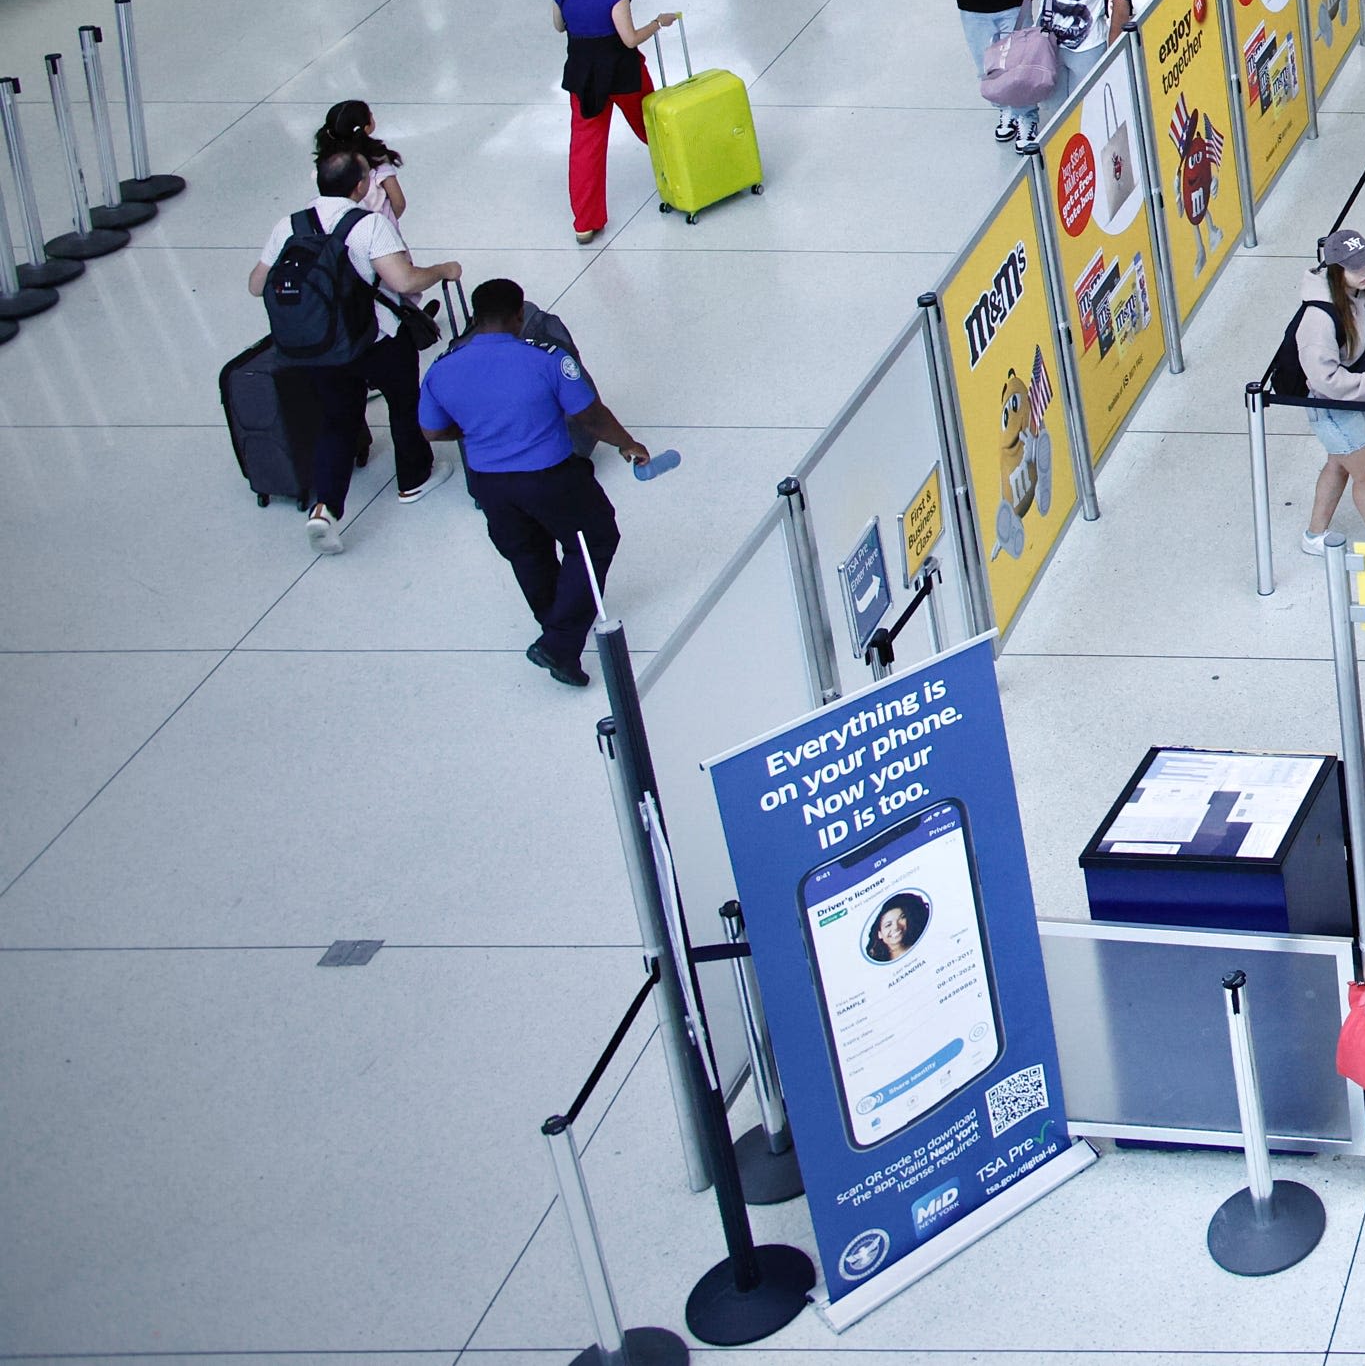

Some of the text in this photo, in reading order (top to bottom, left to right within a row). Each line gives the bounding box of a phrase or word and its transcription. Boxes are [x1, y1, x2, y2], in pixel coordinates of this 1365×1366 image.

[1158, 9, 1192, 63] enjoy
[1162, 30, 1203, 95] together
[908, 501, 937, 549] Business
[910, 490, 932, 527] First &
[847, 542, 868, 576] TSA Pre
[915, 527, 933, 556] Class
[851, 547, 879, 593] Enter Here
[766, 679, 947, 777] Everything is
[760, 706, 963, 812] on your phone.
[802, 745, 933, 826] Now your
[818, 781, 930, 850] ID is too.
[929, 820, 956, 838] Privacy
[815, 870, 831, 883] 9:41
[874, 856, 887, 869] ID's
[817, 895, 854, 918] Driver's
[853, 876, 886, 900] license
[888, 959, 927, 989] ALEXANDRA
[837, 997, 867, 1016] SAMPLE
[837, 1108, 977, 1205] Scan QR code to download
[852, 1120, 979, 1207] the app. Valid New York
[897, 1133, 981, 1193] license required.
[976, 1137, 1034, 1183] TSA Pre
[985, 1143, 1057, 1196] tsa.gov/digital-id
[918, 1201, 960, 1231] NEW YORK
